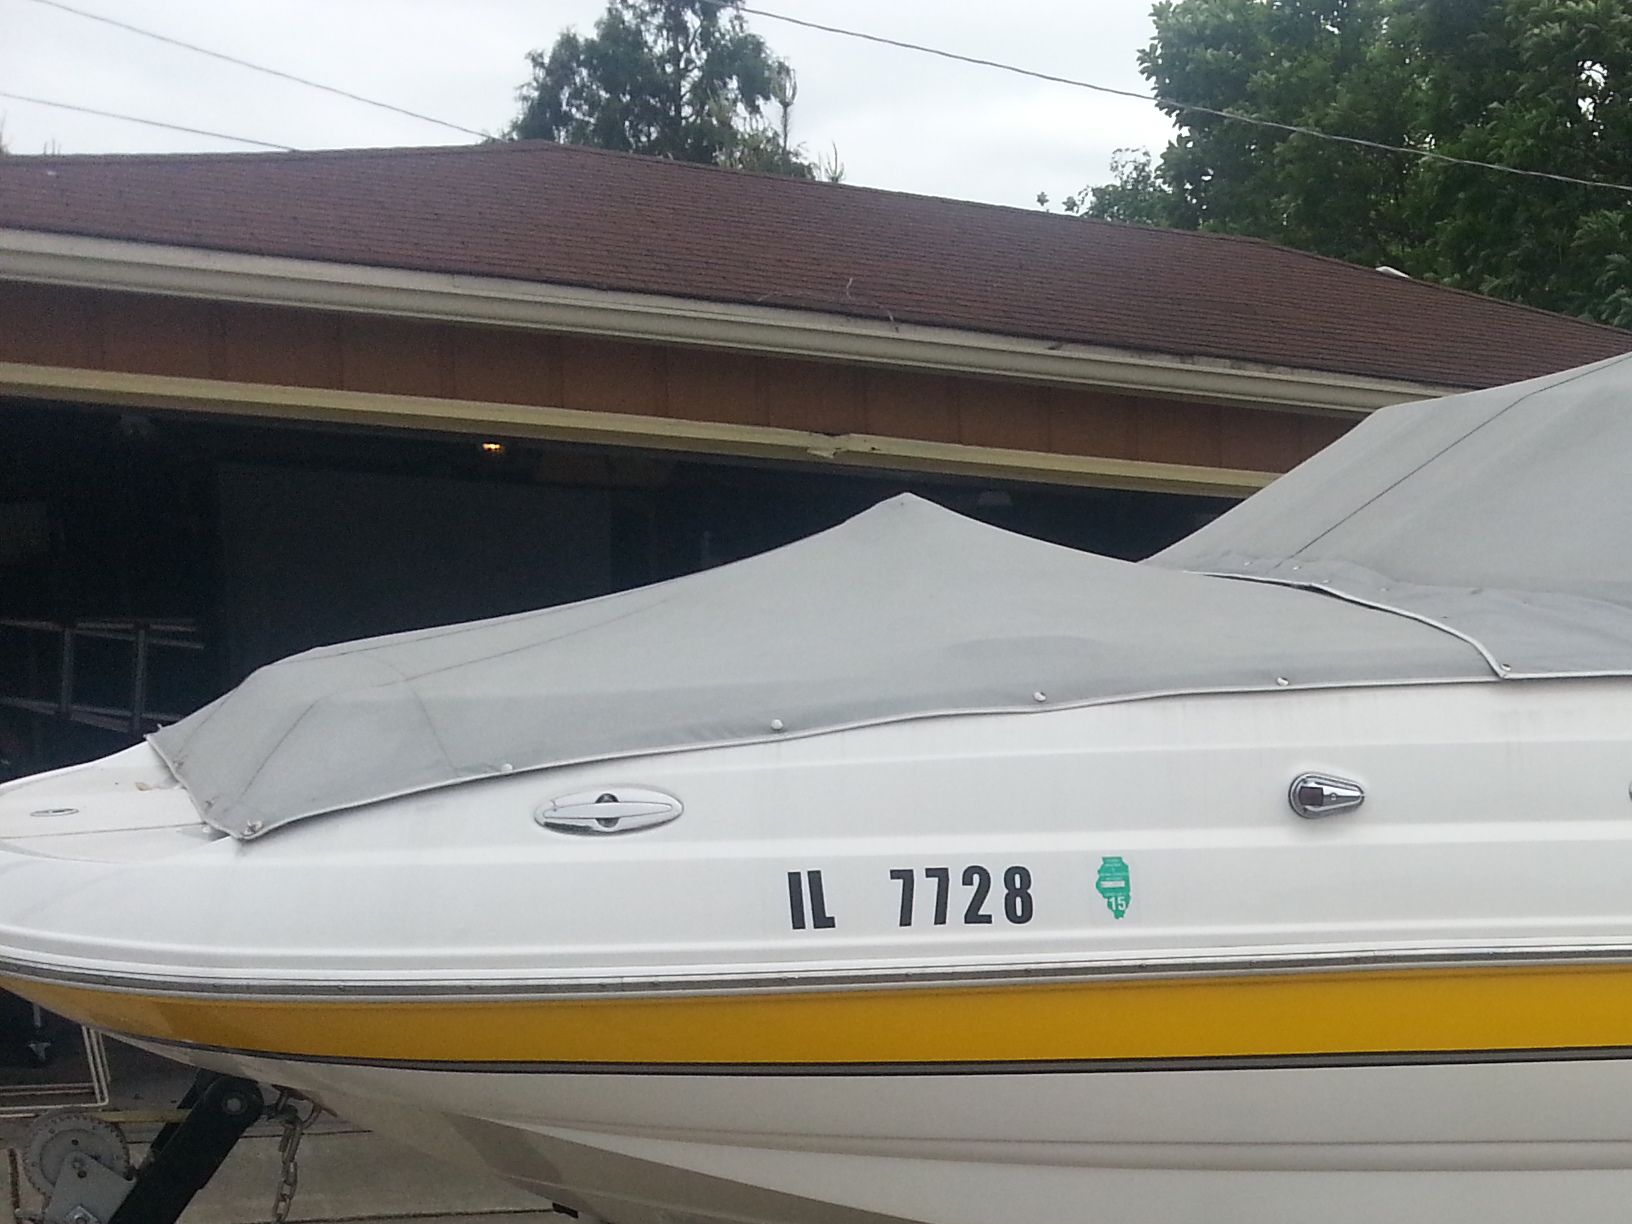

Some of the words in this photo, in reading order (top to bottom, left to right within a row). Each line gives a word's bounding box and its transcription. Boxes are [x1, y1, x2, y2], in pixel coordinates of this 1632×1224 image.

[787, 870, 836, 930] IL
[889, 865, 1034, 927] 7728
[1109, 896, 1126, 910] 15
